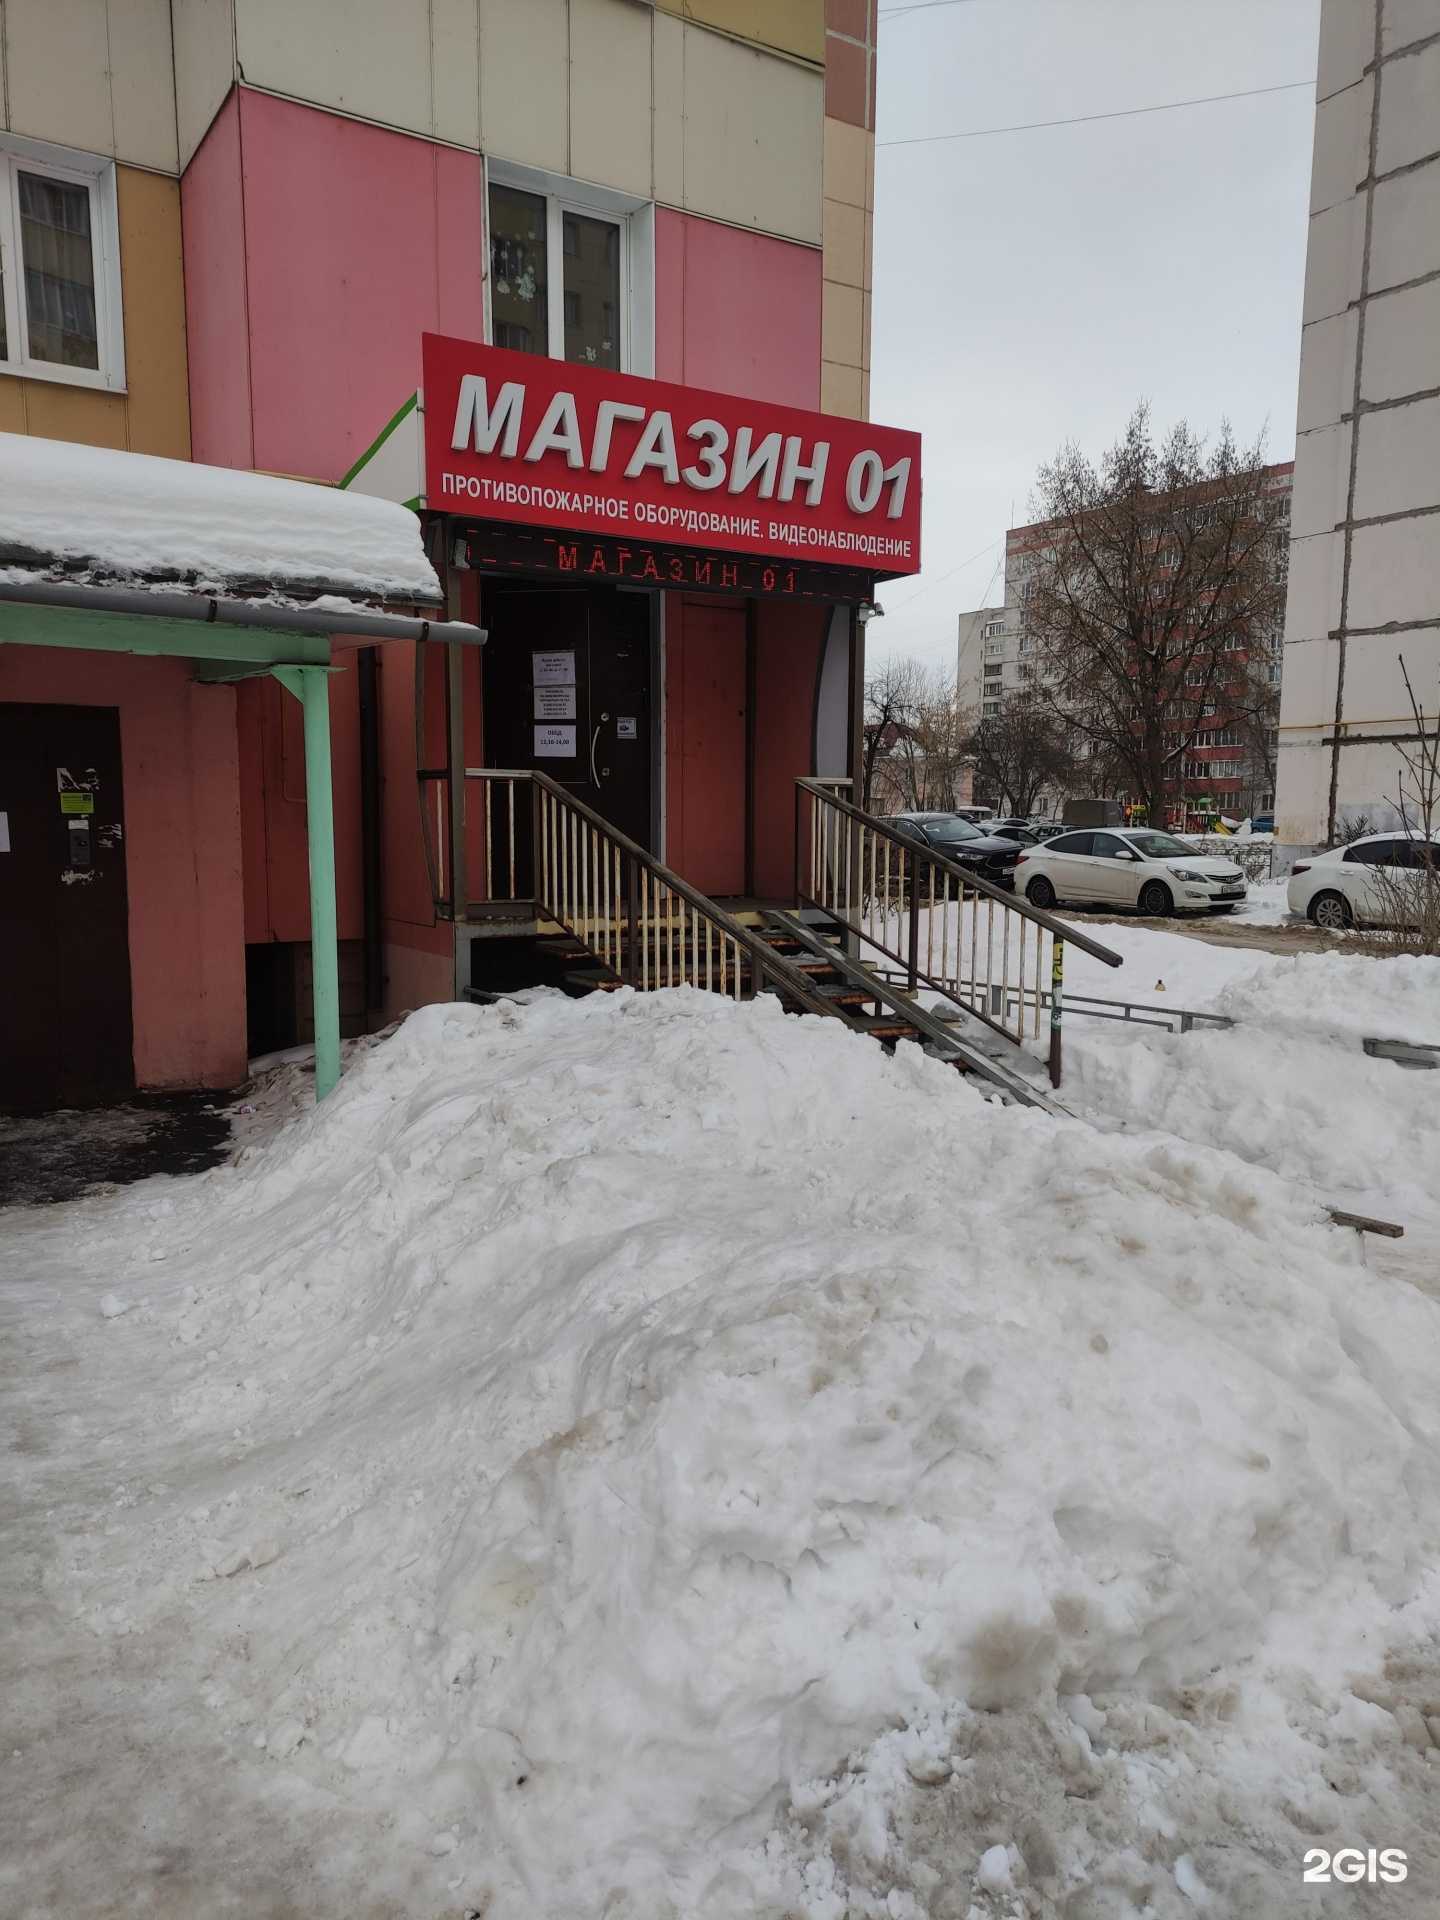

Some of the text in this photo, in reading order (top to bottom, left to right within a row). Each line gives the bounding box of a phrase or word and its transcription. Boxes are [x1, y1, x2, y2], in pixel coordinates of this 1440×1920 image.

[450, 373, 912, 519] МАГАЗИН 01
[442, 472, 912, 558] ПРОТИВОПОЖАРНОЕ ОБОРУДОВАНИЕ. ВИДЕОНАБЛЮДЕНИЕ
[557, 545, 798, 593] МАГАЗИН 01
